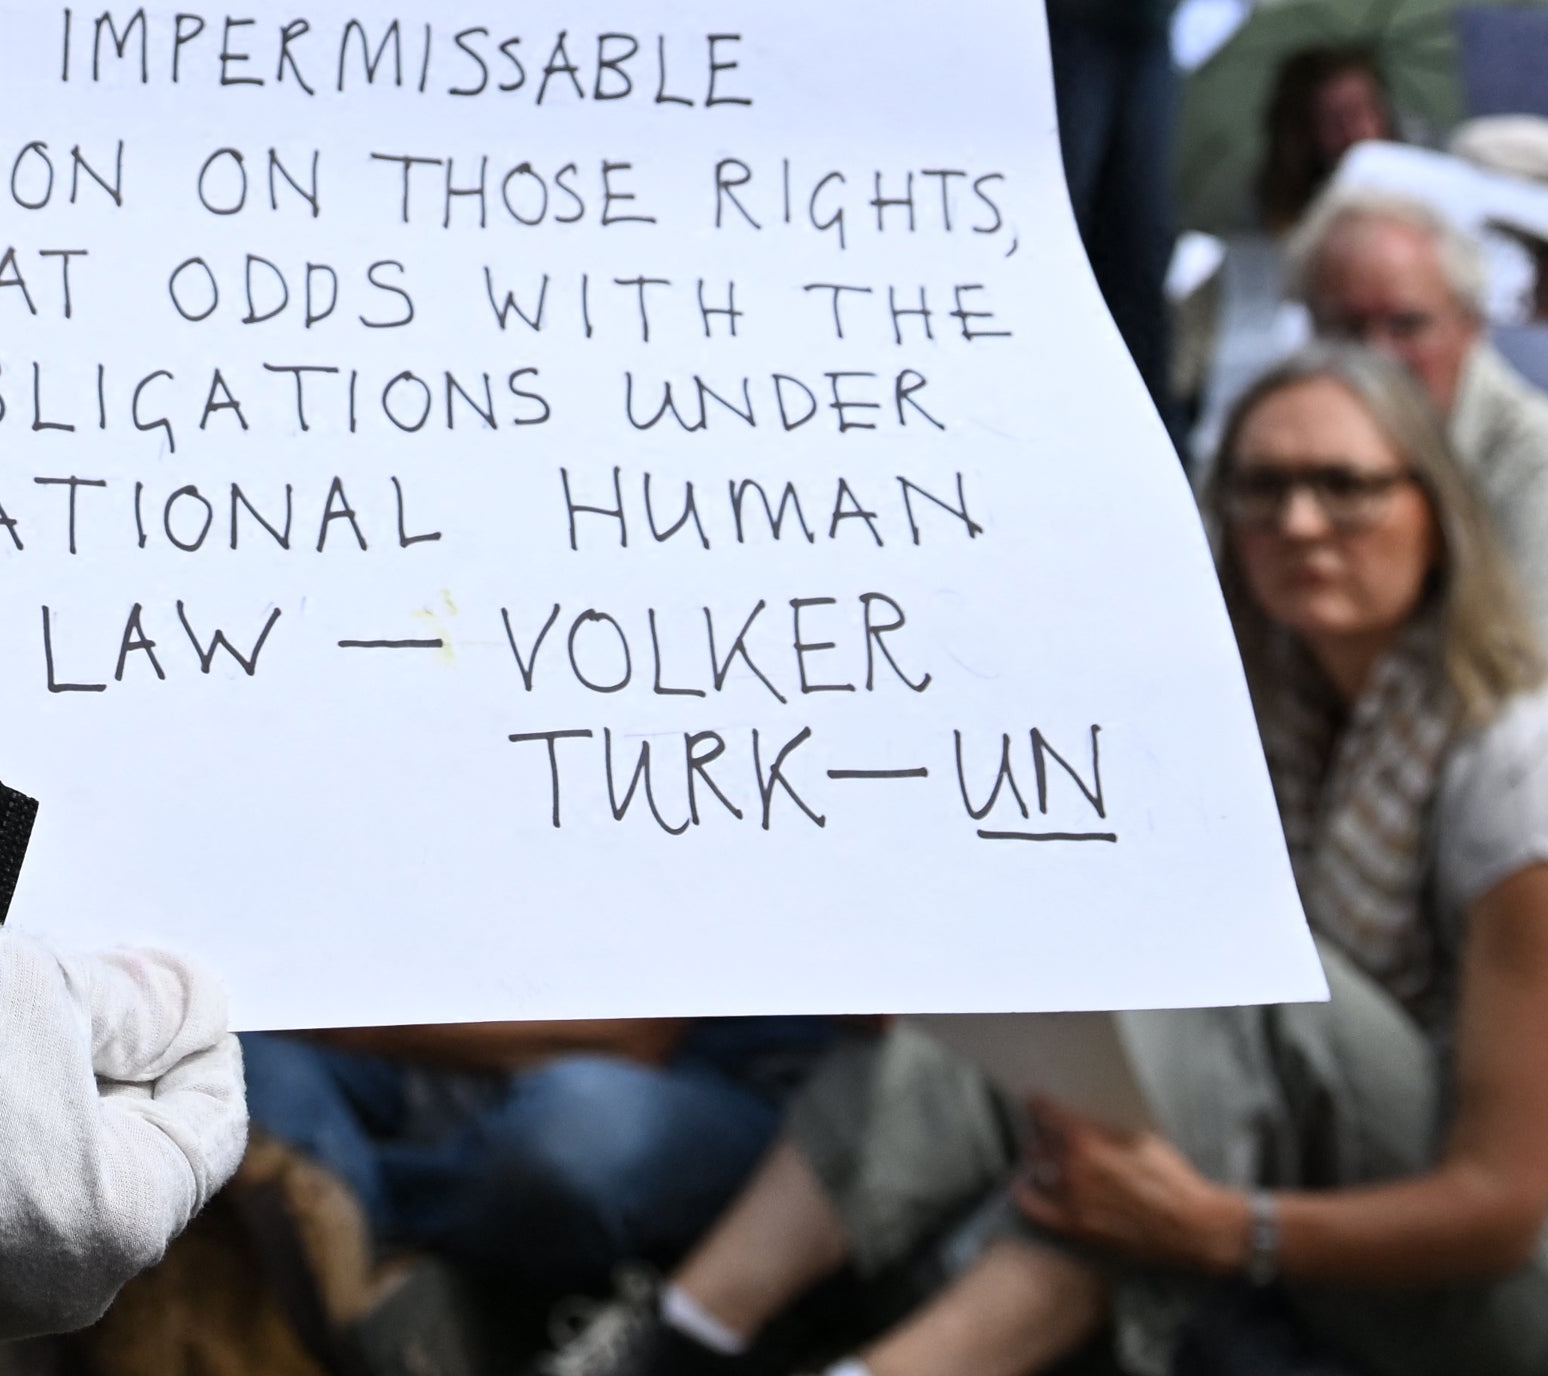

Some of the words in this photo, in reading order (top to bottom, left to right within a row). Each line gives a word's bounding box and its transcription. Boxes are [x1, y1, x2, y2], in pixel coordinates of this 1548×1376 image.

[61, 7, 752, 108] IMPERMISSABLE
[198, 147, 320, 218] ON
[370, 152, 656, 229] THOSE
[715, 158, 1018, 257] RIGHTS,
[169, 254, 414, 329] ODDS
[484, 266, 743, 343] WITH
[803, 284, 1012, 345] THE
[625, 369, 945, 433] UNDER
[560, 466, 983, 551] HUMAN
[42, 600, 282, 693] LAW
[501, 592, 932, 704] VOLKER
